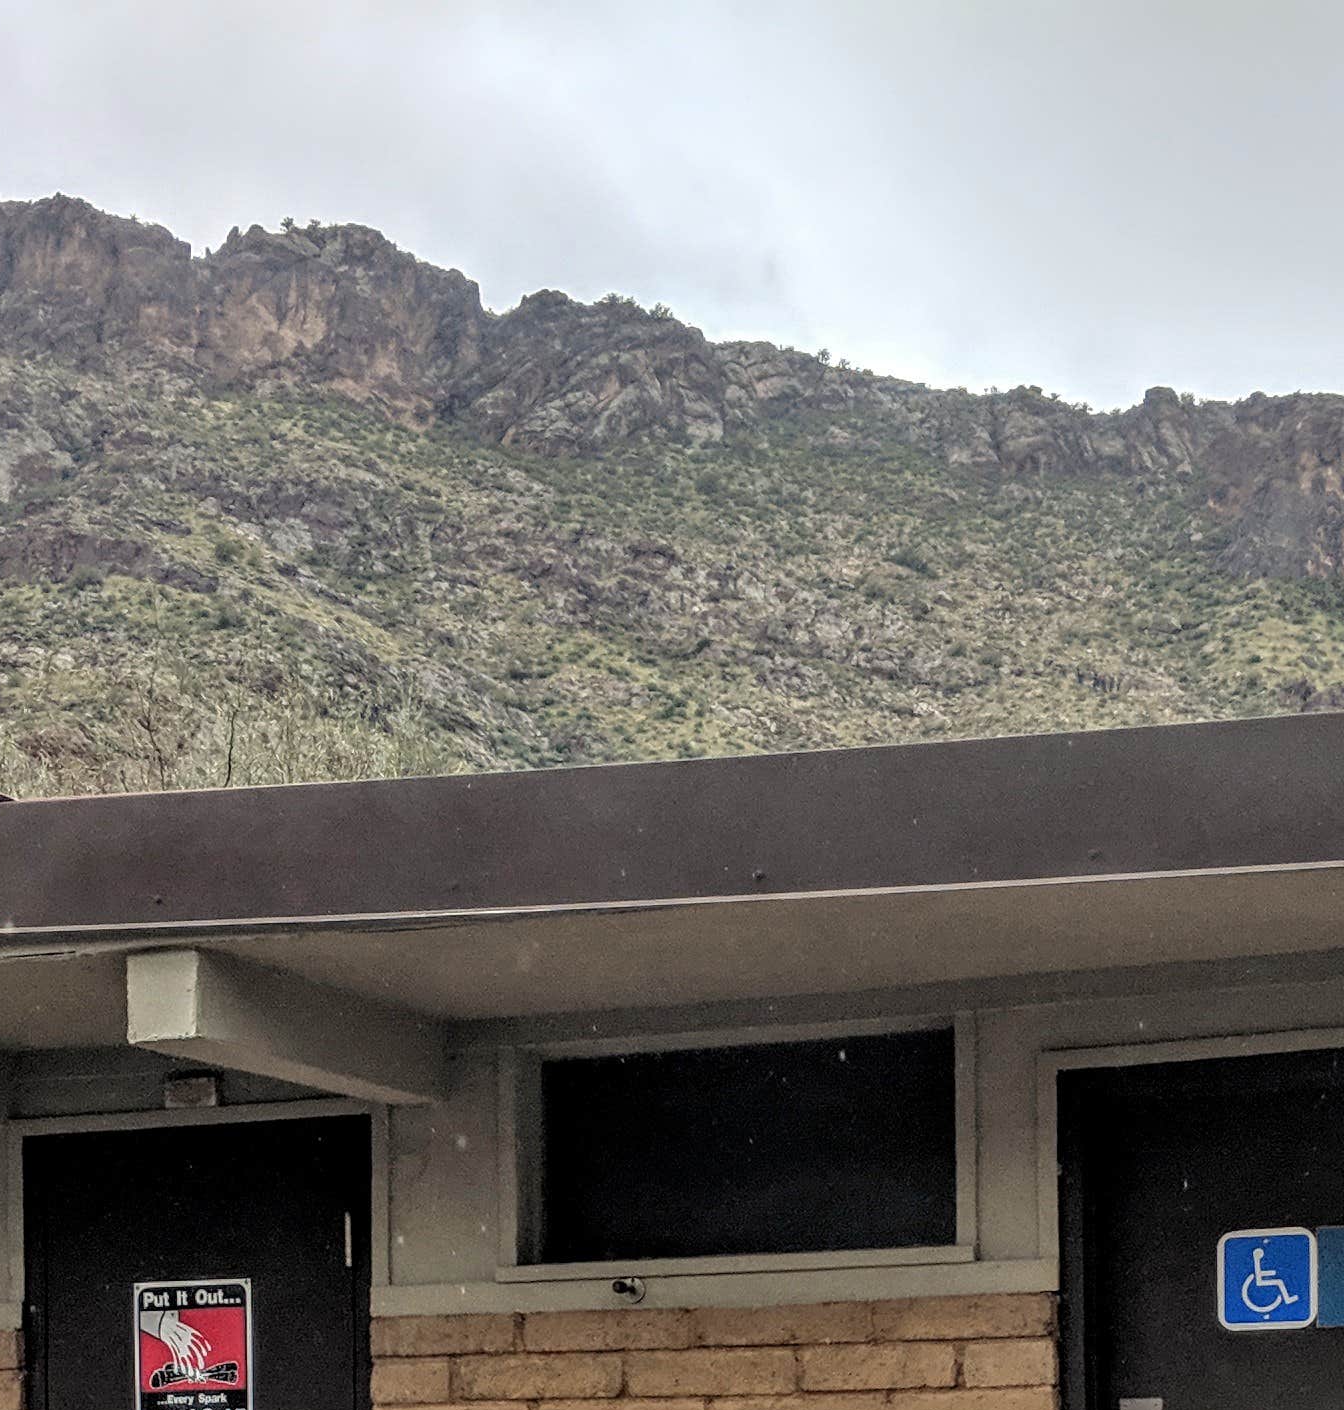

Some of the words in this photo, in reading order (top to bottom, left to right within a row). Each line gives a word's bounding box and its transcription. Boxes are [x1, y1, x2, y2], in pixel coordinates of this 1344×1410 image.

[143, 1291, 170, 1309] Put
[176, 1289, 188, 1306] It
[198, 1392, 227, 1405] Spark
